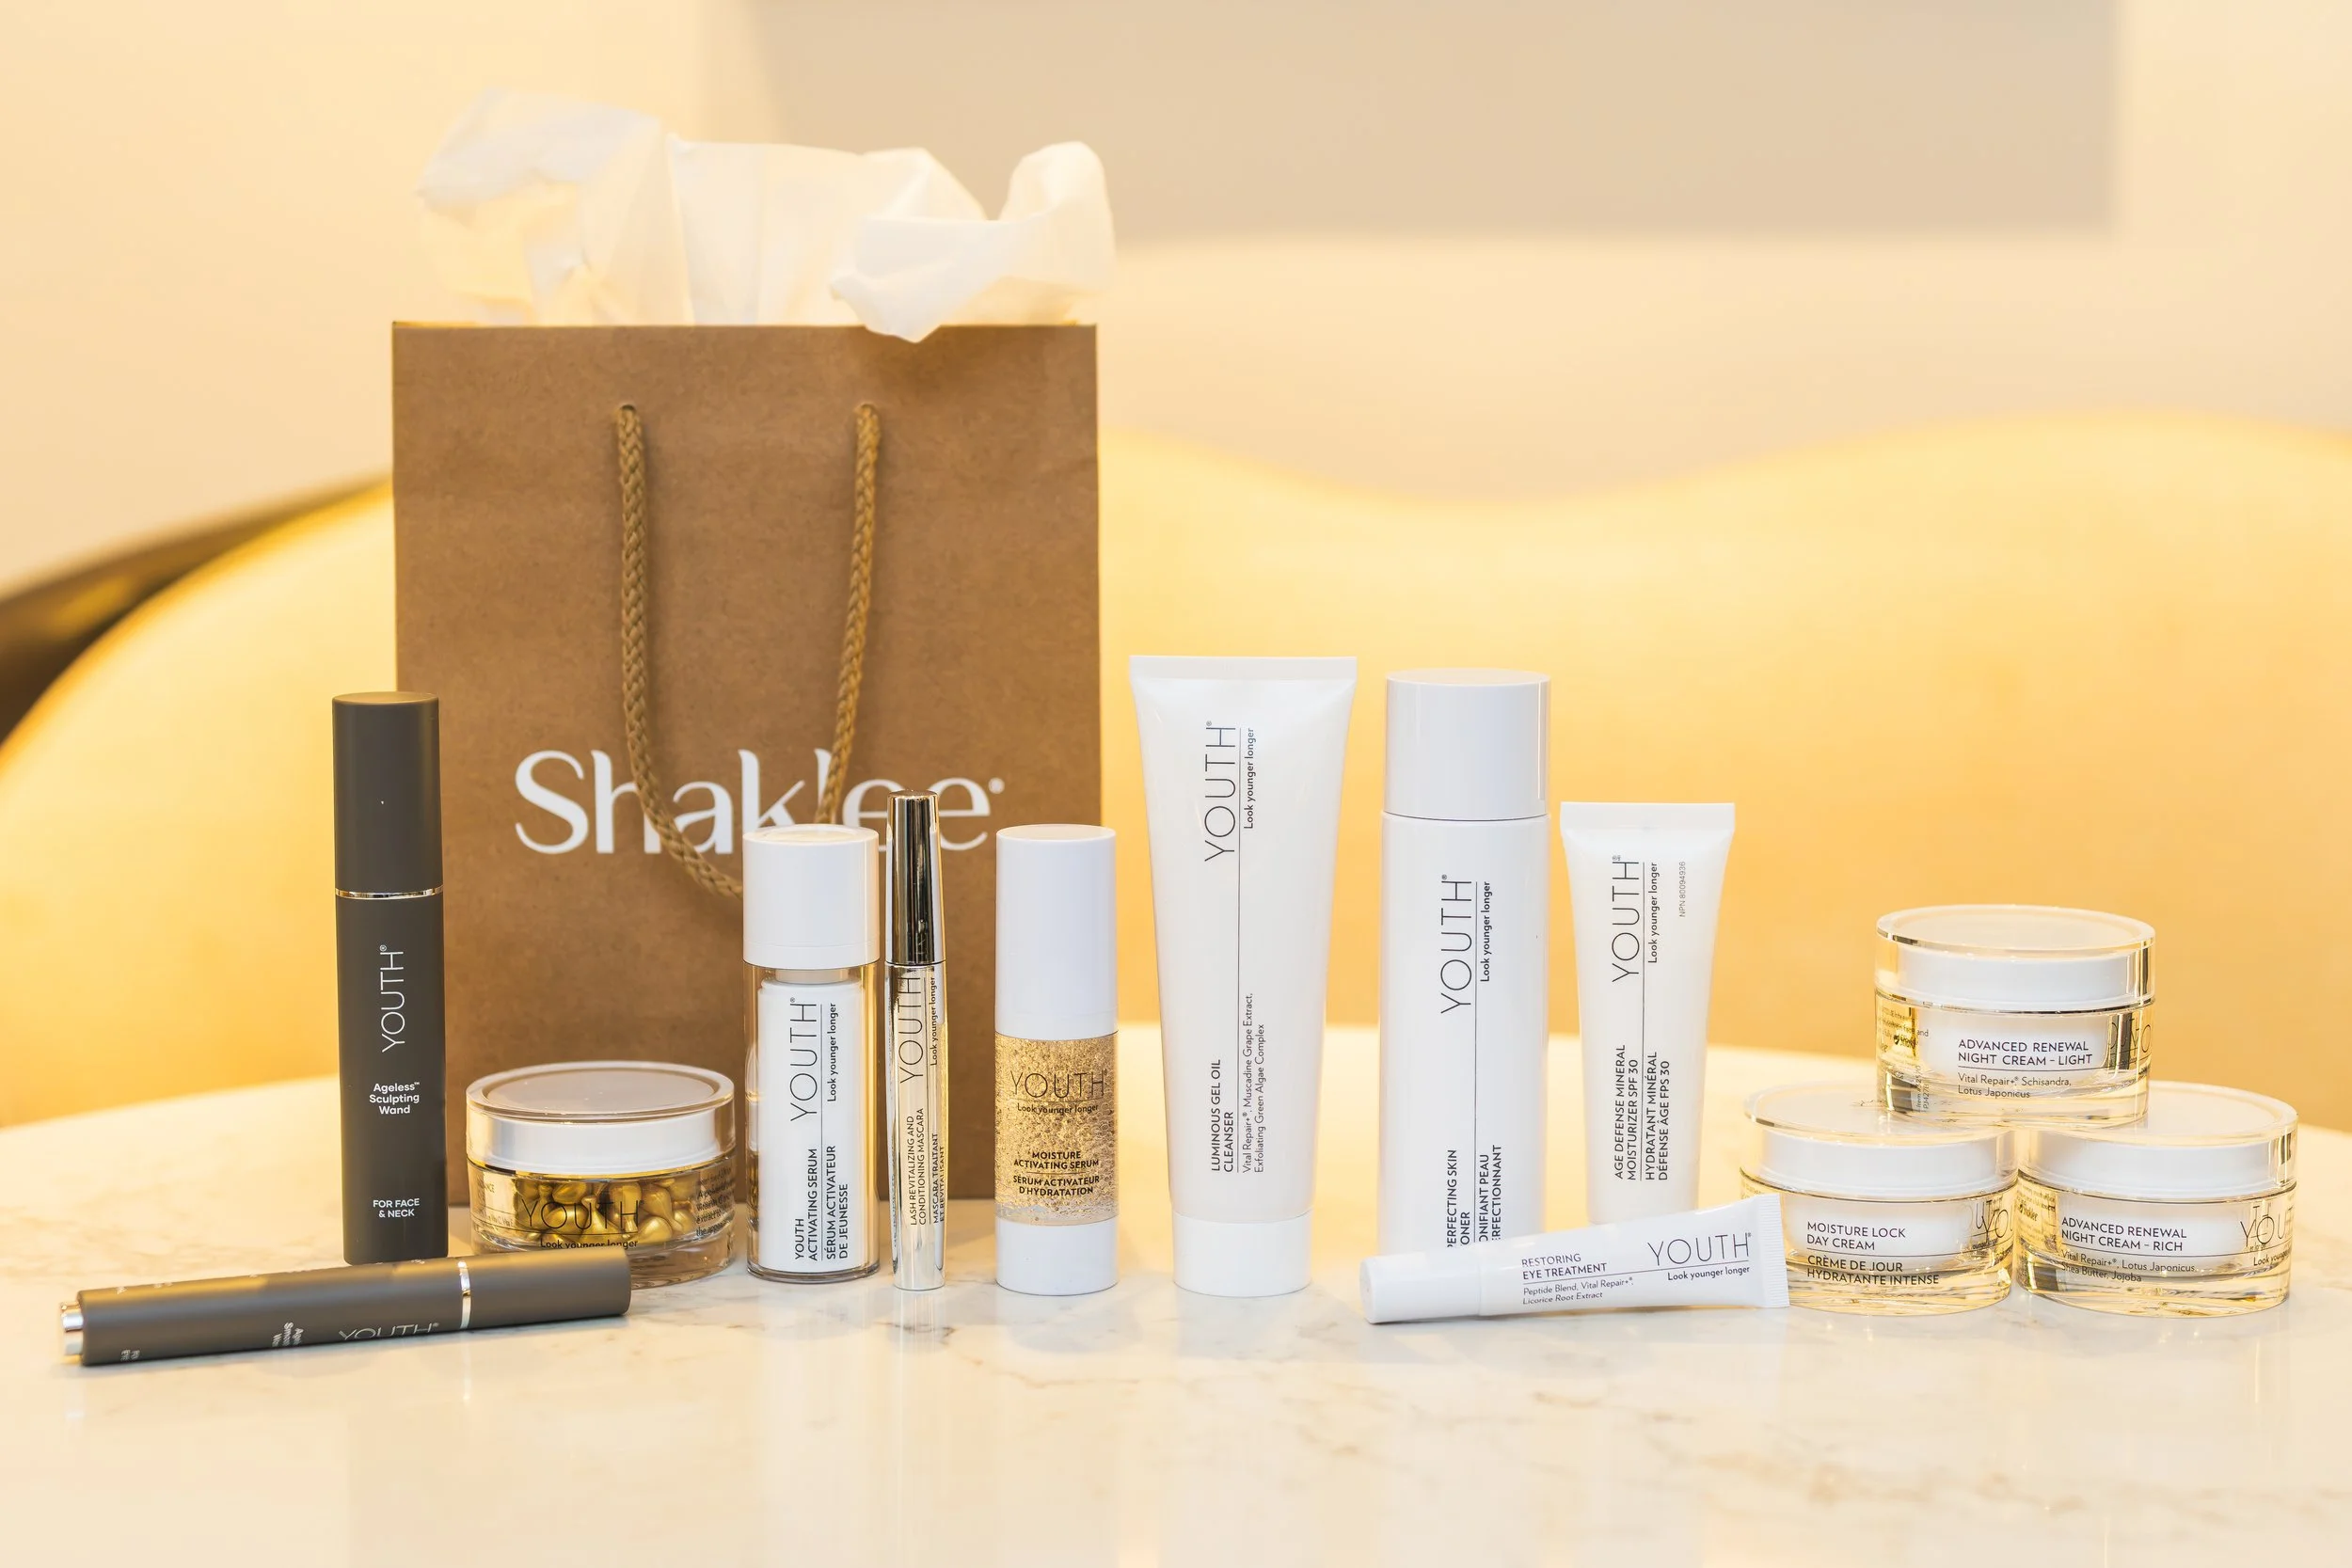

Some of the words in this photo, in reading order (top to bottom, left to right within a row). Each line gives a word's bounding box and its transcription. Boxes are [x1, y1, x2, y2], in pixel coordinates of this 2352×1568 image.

[1244, 728, 1256, 759] longer
[1247, 761, 1256, 802] younger
[1244, 804, 1253, 830] Look
[1648, 863, 1660, 893] longer
[1481, 881, 1492, 913] longer
[1651, 896, 1660, 937] younger
[1483, 915, 1492, 956] younger
[1648, 939, 1657, 963] Look
[1480, 958, 1490, 982] Look
[929, 977, 938, 1006] longer
[827, 1003, 838, 1034] longer
[930, 1006, 939, 1041] younger
[1243, 1029, 1254, 1057] Grape
[1254, 1024, 1266, 1065] Complex
[1958, 1038, 2027, 1053] ADVANCED
[2032, 1041, 2090, 1053] RENEWAL
[830, 1036, 838, 1076] younger
[1629, 1059, 1638, 1075] 30
[1660, 1060, 1670, 1075] 30
[1958, 1052, 1997, 1065] NIGHT
[2002, 1055, 2046, 1066] CREAM
[2058, 1053, 2093, 1066] LIGHT
[1211, 1059, 1221, 1080] OIL
[1254, 1067, 1266, 1093] Algae
[1615, 1045, 1626, 1098] MINERAL
[1645, 1052, 1657, 1104] MINÉRAL
[1958, 1072, 1979, 1084] Vital
[2022, 1076, 2072, 1086] Schisandra,
[827, 1078, 836, 1101] Look
[1211, 1083, 1221, 1105] GEL
[1243, 1059, 1252, 1107] Muscadine
[1629, 1077, 1638, 1098] SPF
[1660, 1078, 1670, 1099] FPS
[1958, 1085, 1982, 1096] Lotus
[1985, 1087, 2030, 1100] Japonicus
[369, 1094, 420, 1105] Sculpting
[378, 1105, 411, 1115] Wand
[1018, 1103, 1037, 1114] Look
[1037, 1106, 1073, 1117] younger
[1074, 1104, 1099, 1114] longer
[1254, 1095, 1263, 1124] Green
[1614, 1100, 1625, 1151] DEFENSE
[1657, 1101, 1669, 1126] ÂGE
[916, 1108, 925, 1153] MASCARA
[1211, 1108, 1221, 1171] LUMINOUS
[1224, 1112, 1233, 1172] CLEANSER
[1627, 1100, 1637, 1180] MOISTURIZER
[1032, 1150, 1081, 1160] MOISTURE
[1254, 1126, 1266, 1173] Exfoliating
[1645, 1107, 1656, 1180] HYDRATANT
[1657, 1129, 1669, 1180] DÉFENSE
[807, 1148, 818, 1188] SERUM
[908, 1139, 916, 1205] REVITALIZING
[1013, 1159, 1068, 1170] ACTIVATING
[1070, 1159, 1099, 1169] SERUM
[1243, 1152, 1252, 1173] Vital
[1447, 1149, 1457, 1177] SKIN
[1479, 1154, 1489, 1184] PEAU
[1614, 1154, 1624, 1180] AGE
[826, 1146, 836, 1218] ACTIVATEUR
[917, 1154, 927, 1226] CONDITIONING
[1044, 1176, 1100, 1187] ACTIVATEUR
[1492, 1145, 1502, 1241] RFECTIONNANT
[373, 1199, 392, 1209] FOR
[395, 1197, 421, 1208] FACE
[388, 1209, 415, 1218] NECK
[839, 1183, 849, 1240] JEUNESSE
[909, 1205, 917, 1226] LASH
[1479, 1187, 1489, 1242] ONIFIANT
[807, 1190, 818, 1261] ACTIVATING
[1460, 1212, 1470, 1246] ONER
[1806, 1221, 1868, 1237] MOISTURE
[1871, 1227, 1906, 1238] LOCK
[2061, 1216, 2124, 1235] ADVANCED
[2127, 1226, 2187, 1239] RENEWAL
[540, 1238, 563, 1249] Look
[794, 1218, 804, 1259] YOUTH
[824, 1220, 836, 1259] SÉRUM
[839, 1243, 849, 1259] DE
[1806, 1234, 1829, 1245] DAY
[1832, 1238, 1875, 1251] CREAM
[2061, 1229, 2096, 1244] NIGHT
[2098, 1236, 2141, 1250] CREAM
[2153, 1242, 2183, 1252] RICH
[1521, 1253, 1581, 1267] RESTORING
[1522, 1269, 1542, 1280] EYE
[1545, 1262, 1608, 1277] TREATMENT
[1807, 1255, 1847, 1270] CRÈME
[1850, 1260, 1867, 1271] DE
[1869, 1261, 1903, 1272] JOUR
[2061, 1249, 2079, 1261] Vital
[2122, 1259, 2148, 1271] Lotus
[2061, 1262, 2080, 1275] Shea
[2111, 1270, 2142, 1283] Jojoba
[2253, 1254, 2270, 1266] Look
[1667, 1271, 1689, 1281] Look
[1690, 1270, 1724, 1281] younger
[1725, 1266, 1750, 1277] longer
[1806, 1269, 1886, 1285] HYDRATANTE
[1889, 1275, 1939, 1286] INTENSE
[1523, 1285, 1553, 1296] Peptide
[1581, 1280, 1598, 1290] Vital
[1523, 1296, 1553, 1305] Licorice
[1576, 1291, 1603, 1300] Extract
